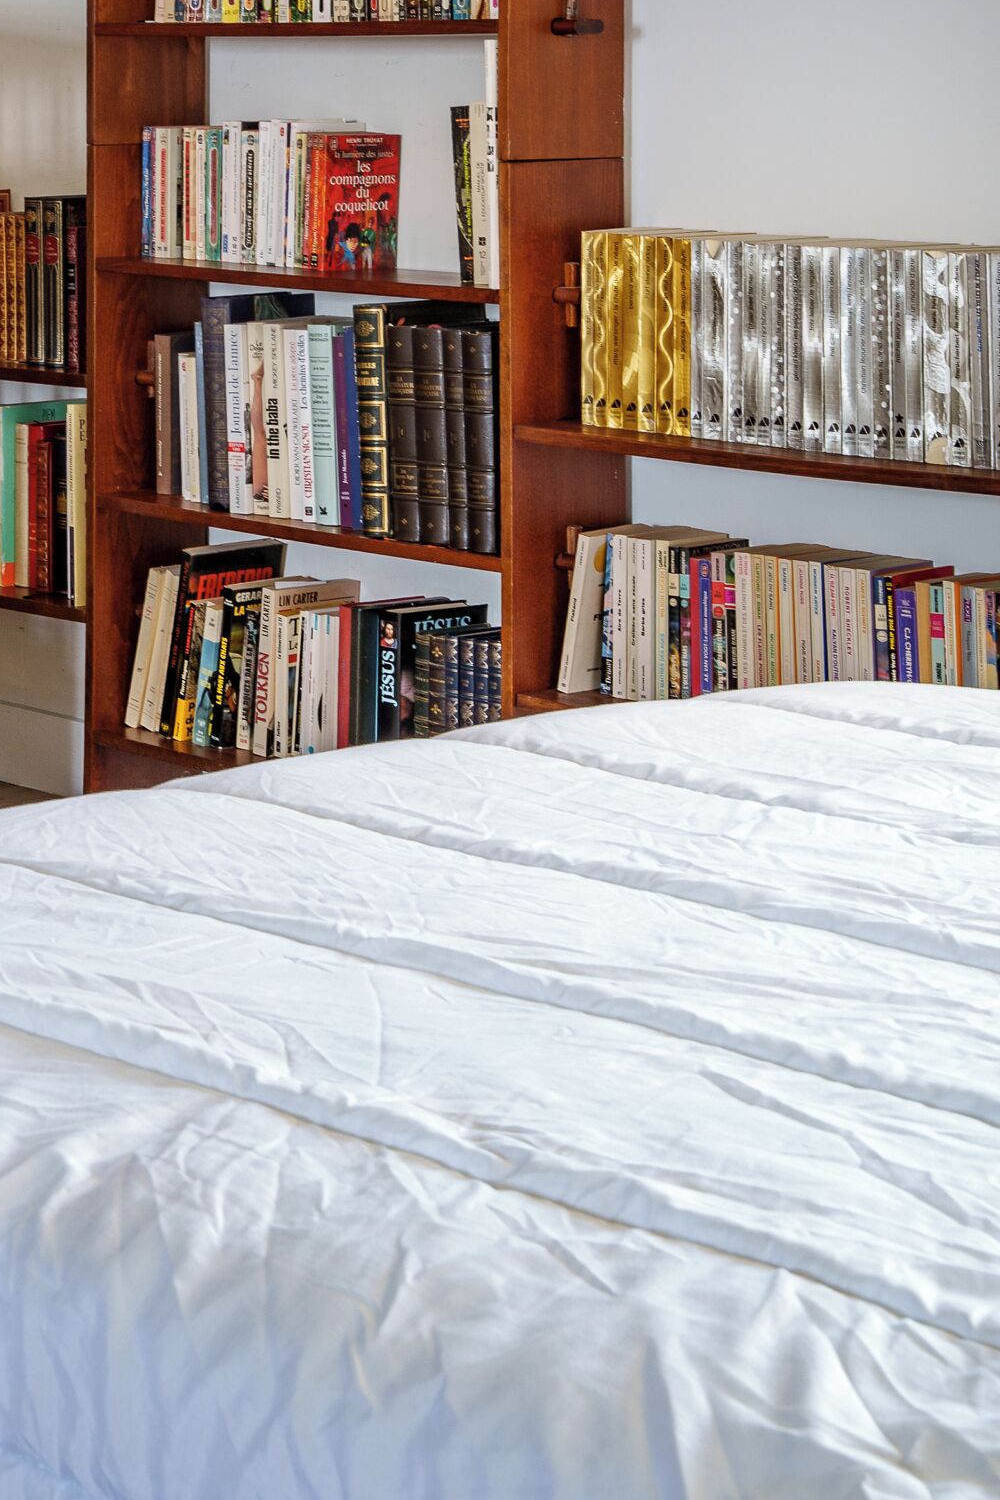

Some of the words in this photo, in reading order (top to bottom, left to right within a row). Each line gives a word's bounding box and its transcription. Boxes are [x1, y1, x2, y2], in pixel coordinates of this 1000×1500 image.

[342, 150, 365, 158] lumière
[377, 151, 394, 159] justes
[357, 161, 371, 171] les
[330, 174, 396, 187] compagnons
[356, 187, 370, 198] du
[334, 200, 389, 214] coquelicot
[229, 331, 239, 372] l'année
[270, 327, 278, 360] SPILLANE
[297, 335, 307, 364] d'étoiles
[230, 374, 239, 390] de
[290, 382, 296, 391] Le
[299, 365, 307, 395] chemins
[266, 398, 279, 425] baba
[299, 397, 308, 410] Les
[230, 391, 243, 436] Journal
[291, 399, 299, 451] CAUWELAERT
[266, 428, 279, 446] the
[301, 423, 310, 455] SIGNOL
[267, 449, 279, 459] in
[293, 467, 301, 486] DIDIER
[303, 456, 313, 498] CHRISTIAN
[235, 590, 262, 603] GERAR
[279, 595, 290, 606] LIN
[293, 592, 319, 605] CARTER
[262, 594, 270, 622] CARTER
[414, 615, 472, 633] JÉSUS
[215, 695, 222, 705] LA
[219, 637, 228, 659] CHATS
[244, 659, 252, 678] DANS
[255, 652, 269, 724] TOLKIEN
[380, 650, 398, 707] JÉSUS
